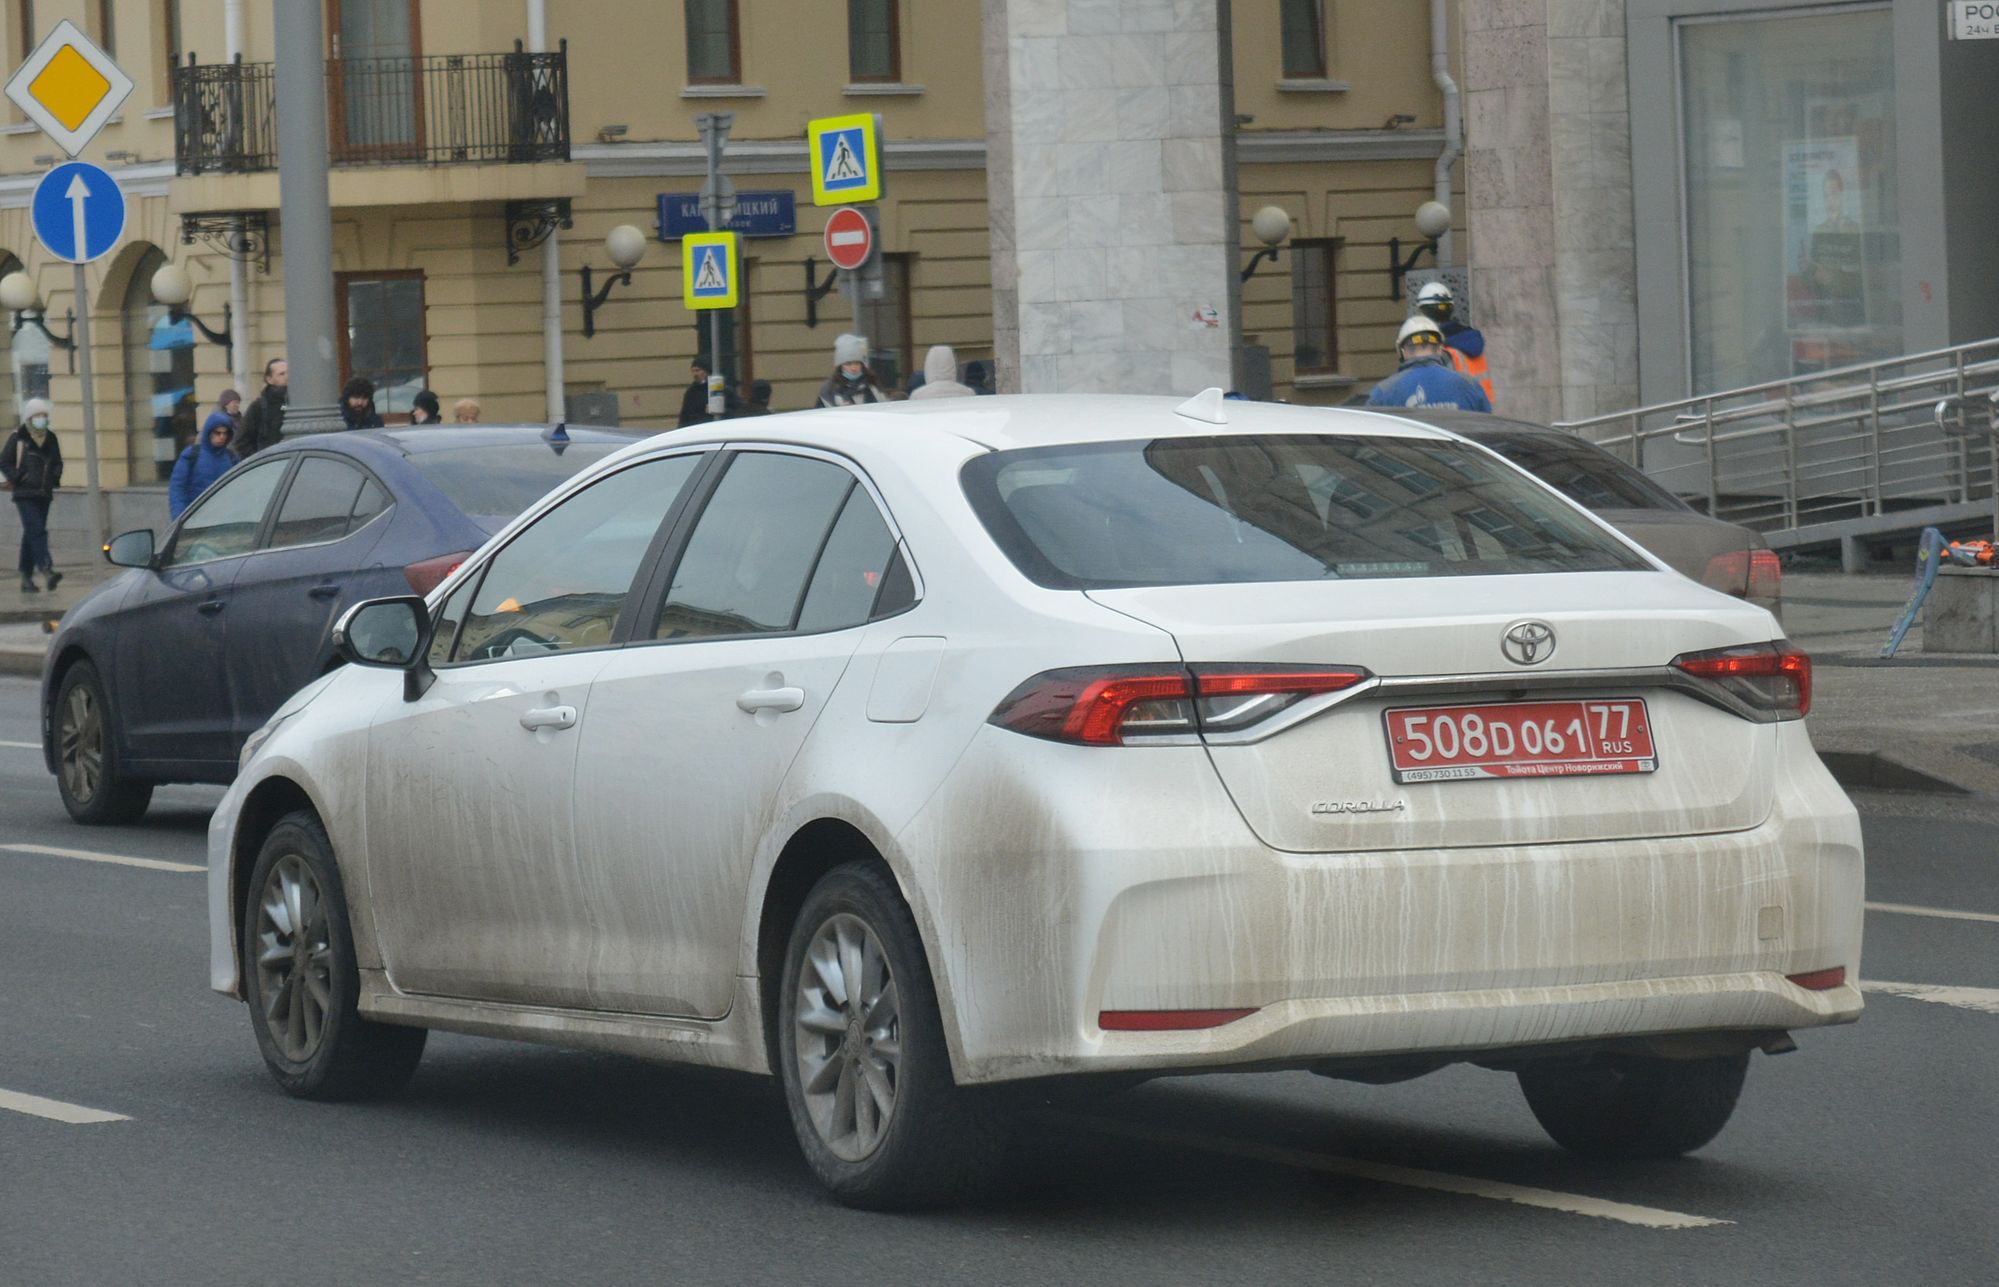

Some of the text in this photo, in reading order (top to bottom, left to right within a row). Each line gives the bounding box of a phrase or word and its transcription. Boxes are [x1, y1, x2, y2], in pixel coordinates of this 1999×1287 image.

[1966, 5, 1999, 20] РО
[681, 198, 778, 217] КАИЦКИЙ
[1590, 705, 1629, 739] 77
[1602, 741, 1632, 753] RUS
[1407, 762, 1624, 780] (495) 730 11 55 Тойота Центр Новорижский
[1311, 800, 1405, 813] COROLLA
